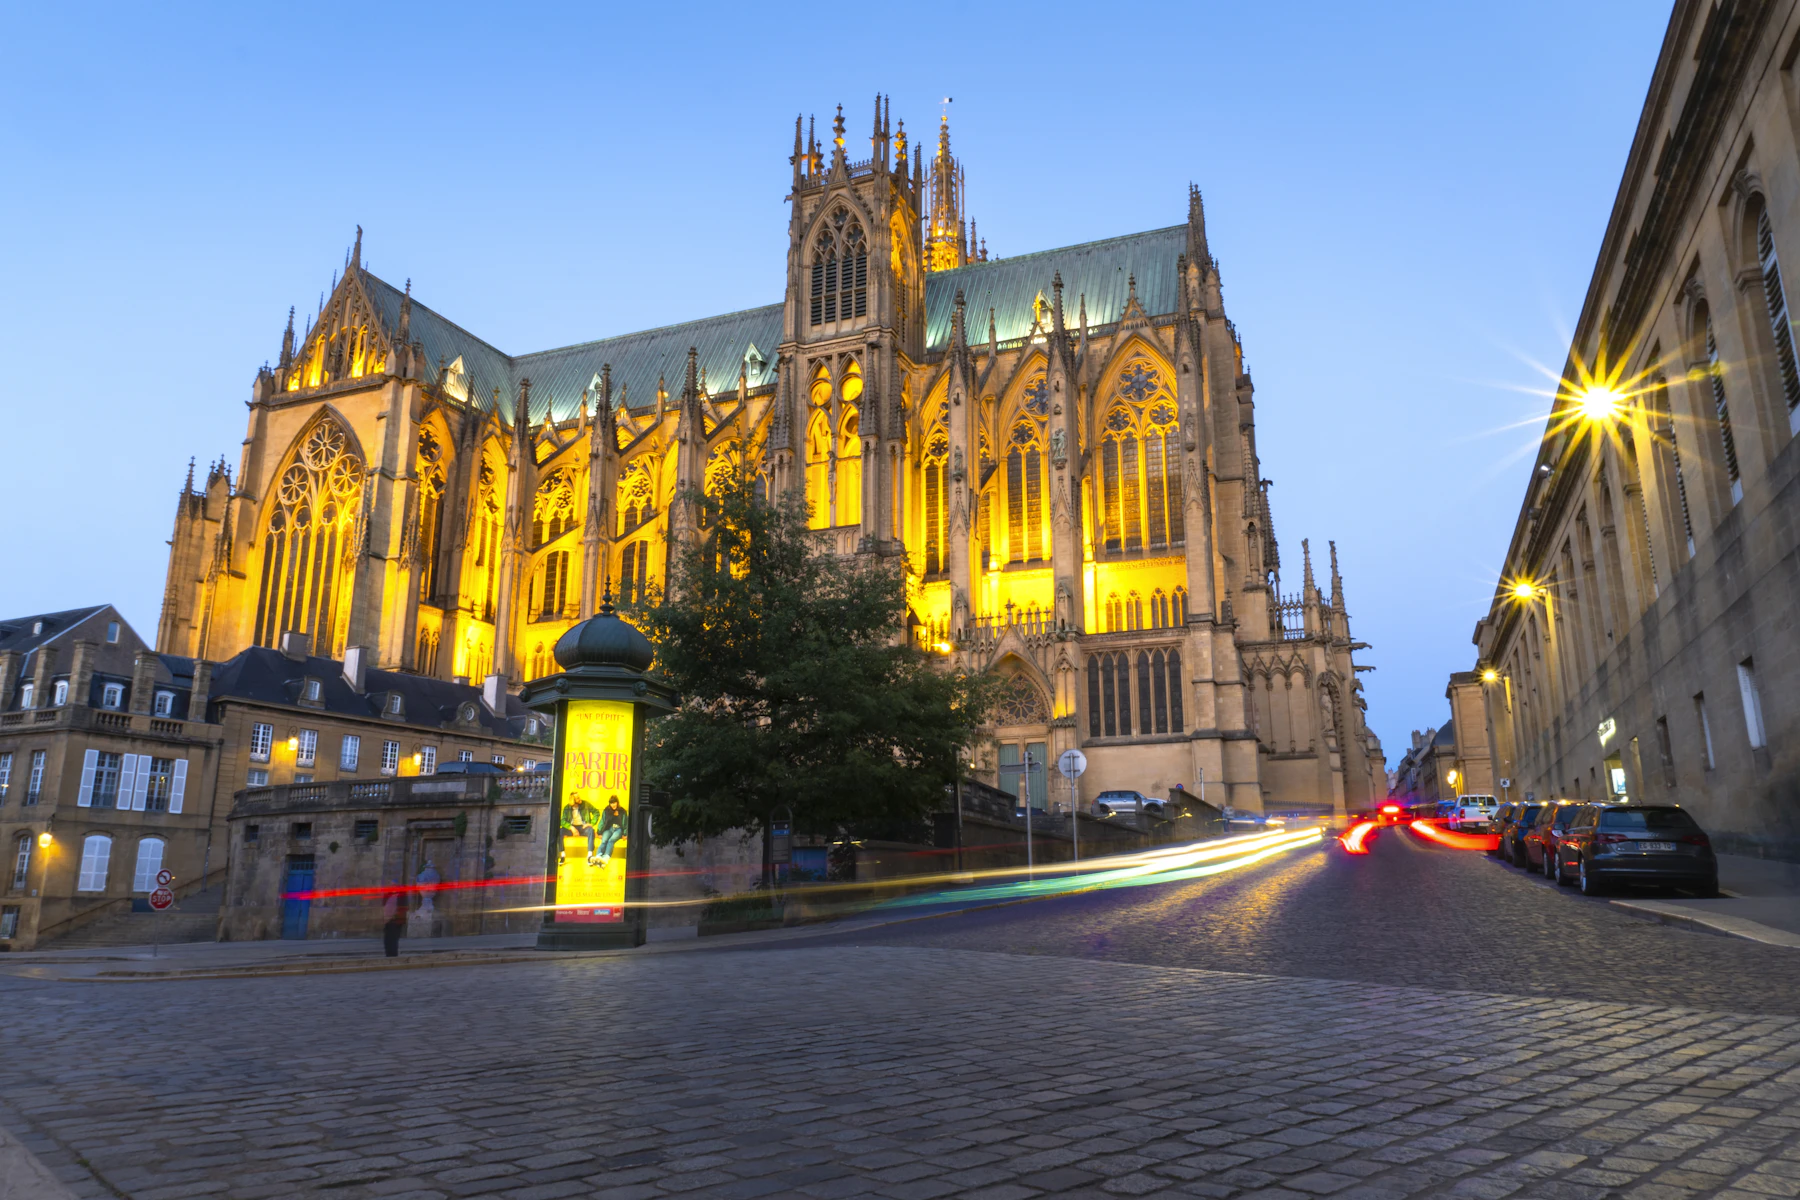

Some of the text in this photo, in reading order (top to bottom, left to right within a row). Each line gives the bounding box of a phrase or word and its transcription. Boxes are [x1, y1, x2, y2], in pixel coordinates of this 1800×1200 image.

[565, 752, 628, 772] PARTIR
[576, 771, 627, 791] JOUR
[152, 895, 171, 903] STOP
